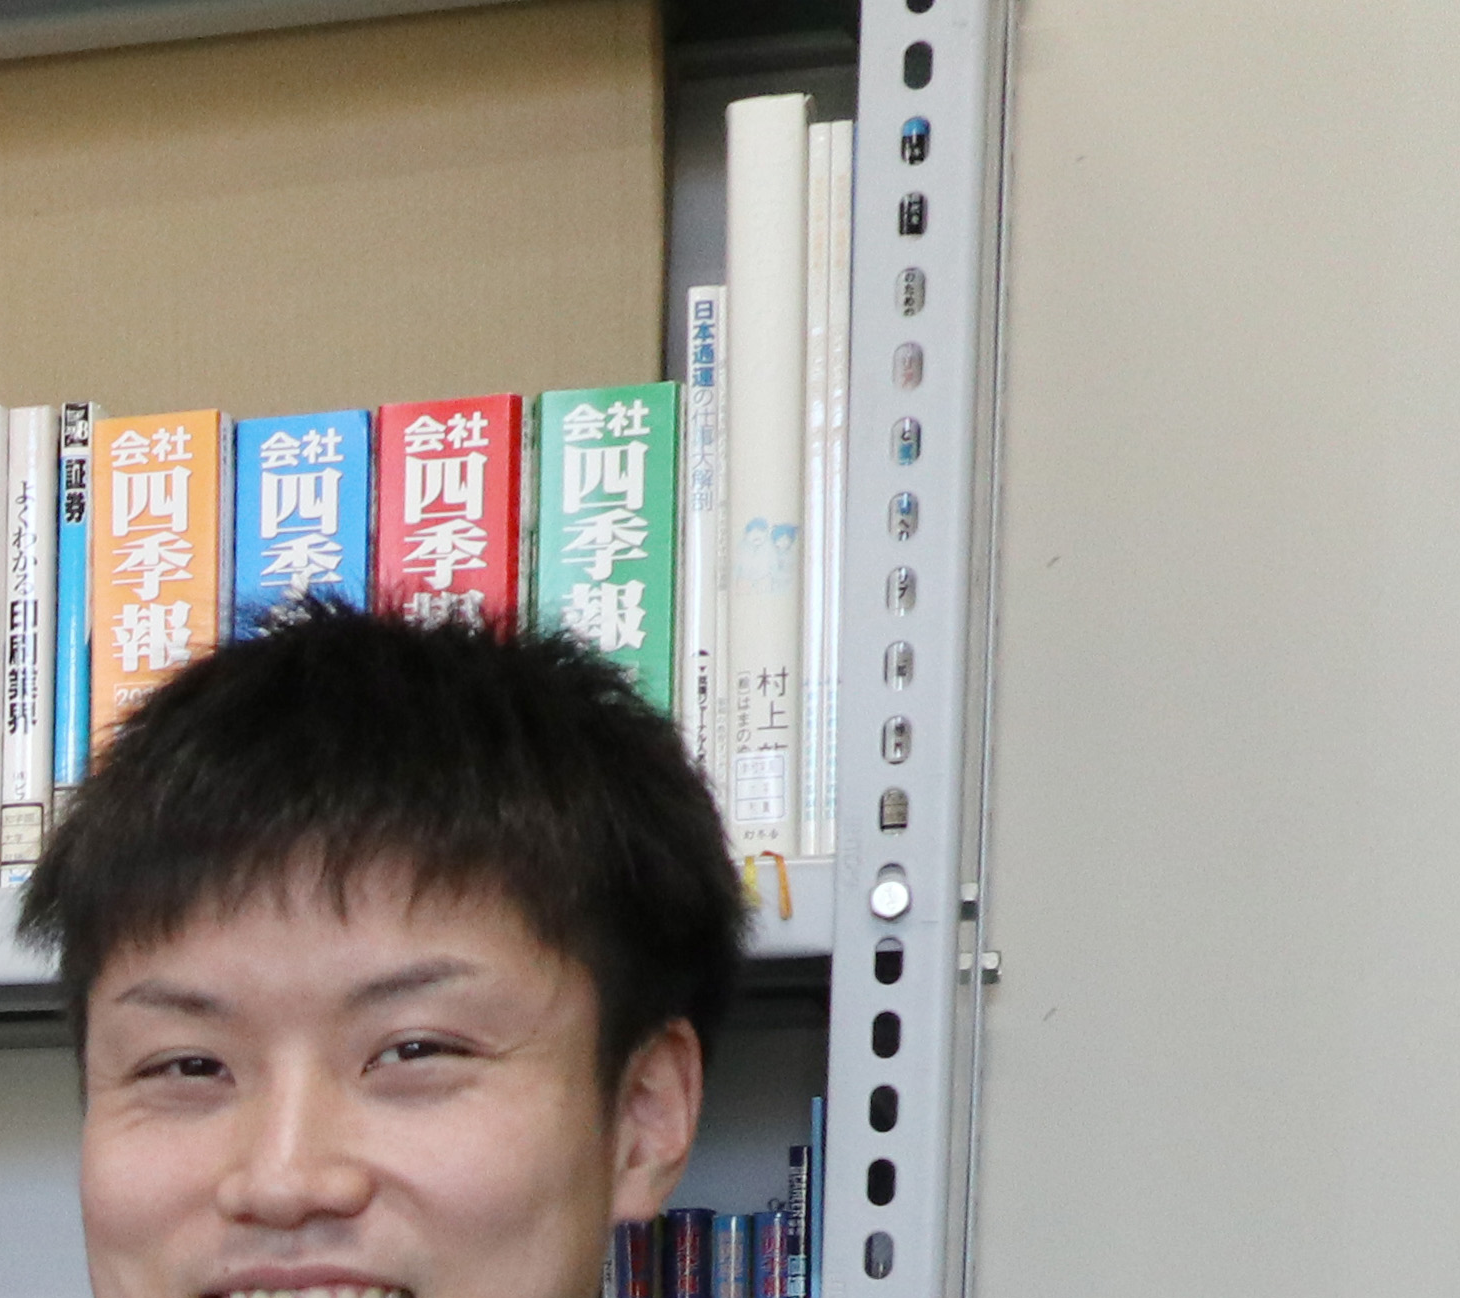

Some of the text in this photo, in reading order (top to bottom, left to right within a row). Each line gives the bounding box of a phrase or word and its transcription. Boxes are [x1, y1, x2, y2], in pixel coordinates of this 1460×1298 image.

[404, 411, 490, 453] 会社
[563, 399, 650, 441] 会社
[692, 301, 714, 512] 日本通運の仕事大解剖
[110, 426, 193, 468] 会社
[260, 427, 344, 468] 会社
[65, 460, 87, 525] 証券
[112, 465, 193, 672] 四季報
[562, 441, 649, 652] 四季報
[7, 480, 39, 736] よくわかる印刷業界
